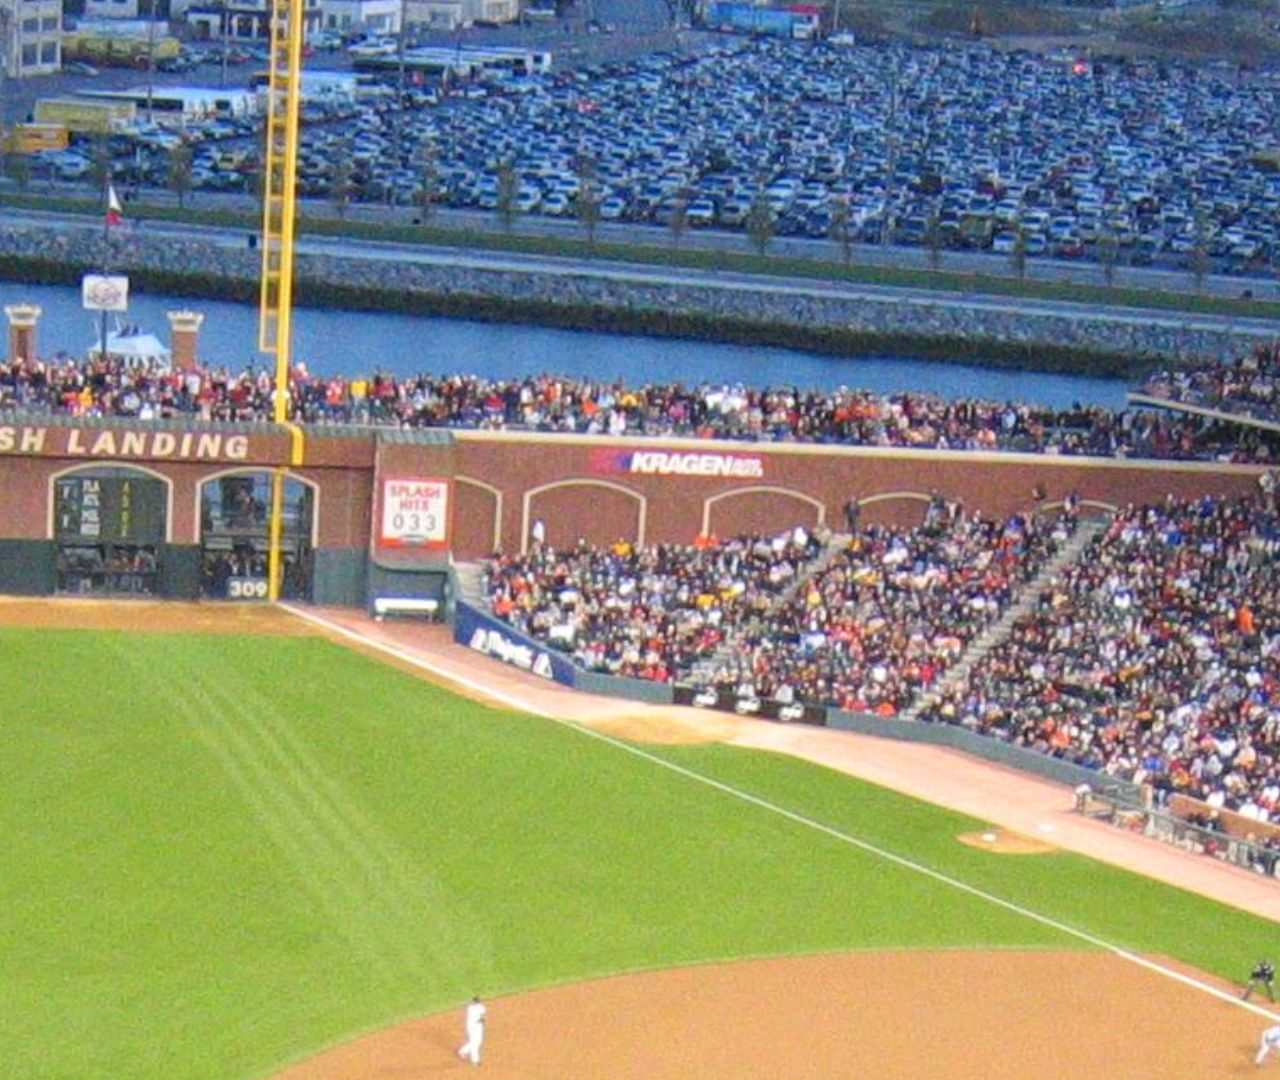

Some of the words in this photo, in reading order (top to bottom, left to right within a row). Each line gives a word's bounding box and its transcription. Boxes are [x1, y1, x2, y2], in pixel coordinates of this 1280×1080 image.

[68, 430, 250, 459] LANDING
[631, 451, 734, 476] KRAGEN
[391, 484, 441, 499] SPLASH
[230, 580, 268, 598] 309
